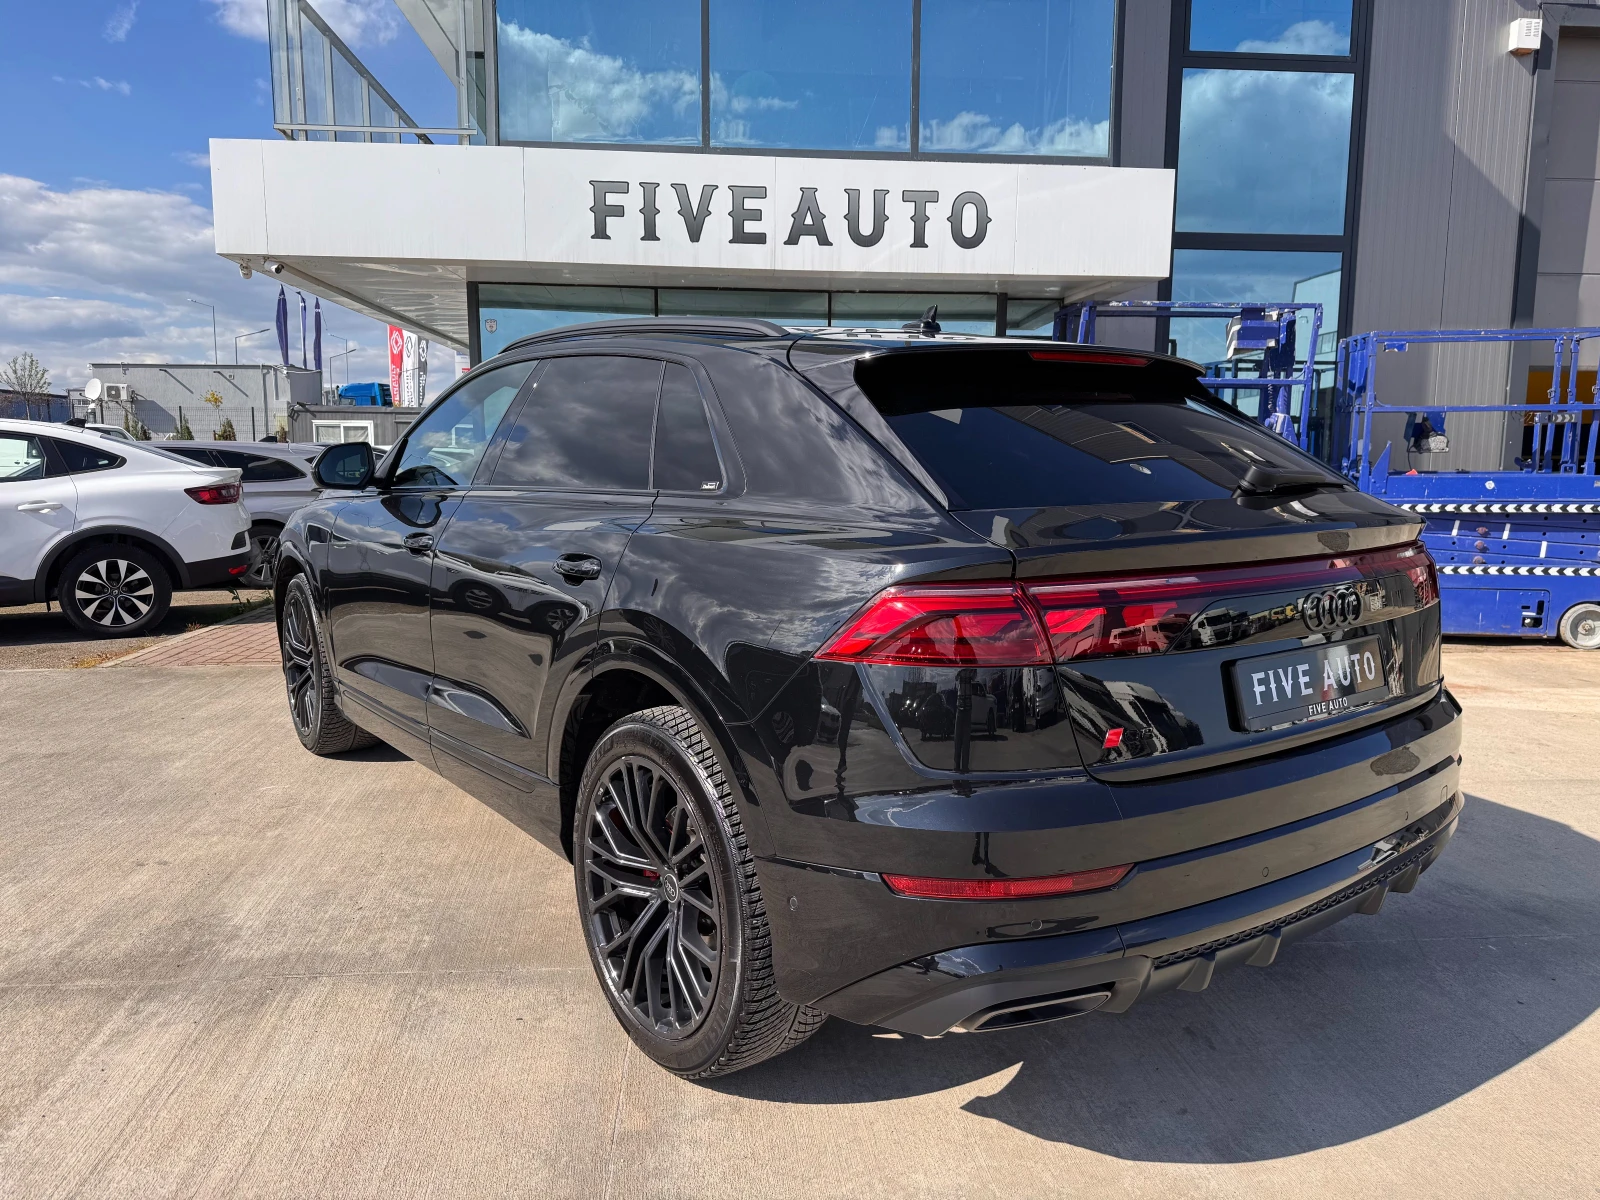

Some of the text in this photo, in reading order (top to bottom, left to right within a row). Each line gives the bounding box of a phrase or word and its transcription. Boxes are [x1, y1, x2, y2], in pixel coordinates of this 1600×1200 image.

[1251, 651, 1375, 705] FIVE AUTO
[1308, 697, 1348, 716] FIVE AUTO
